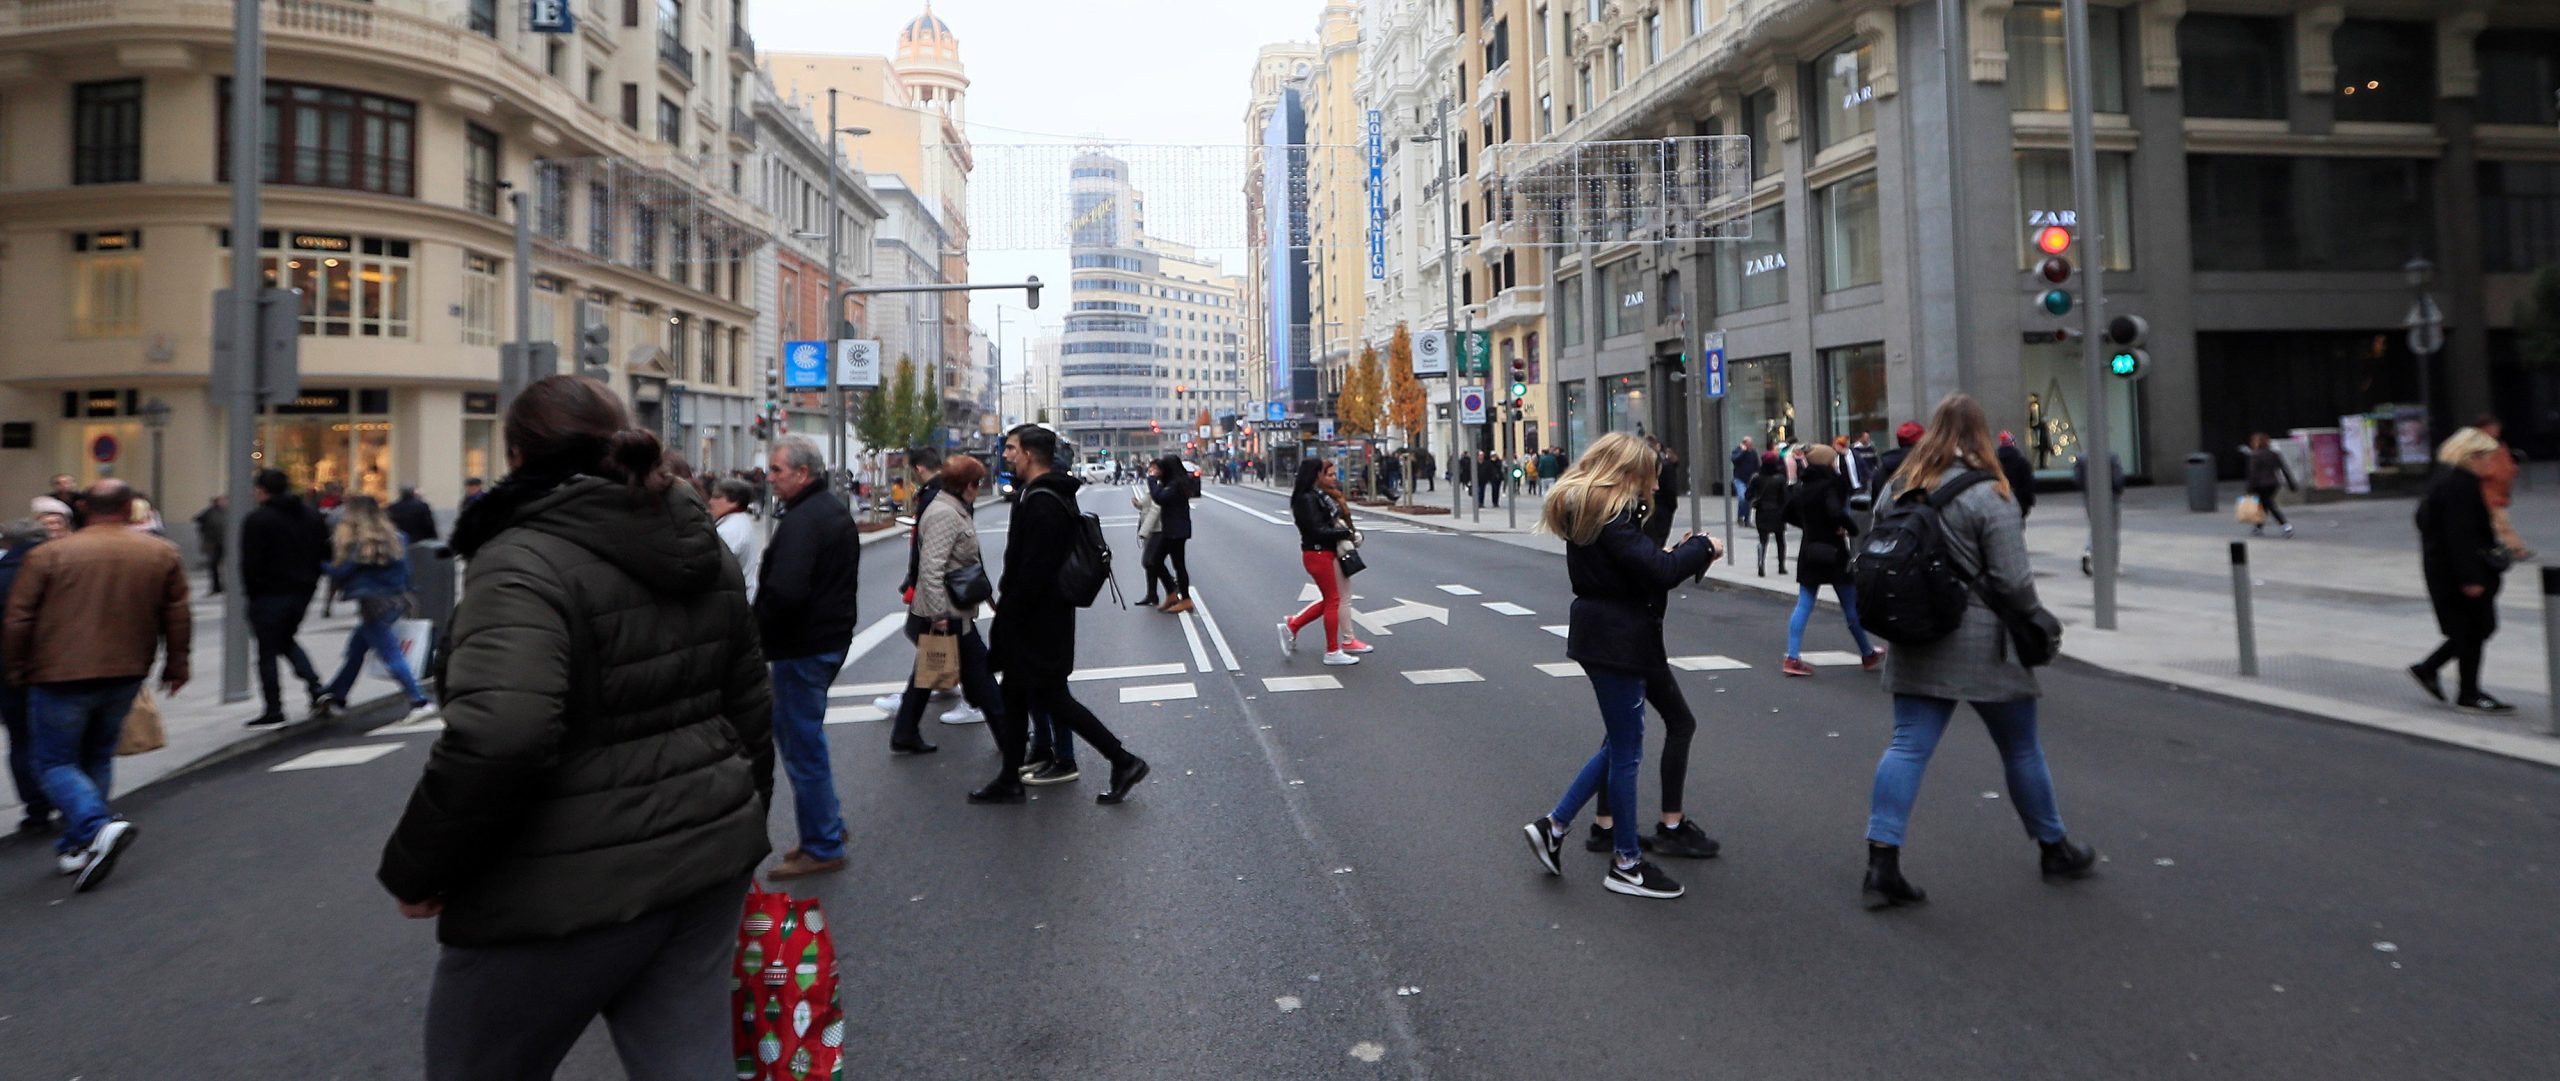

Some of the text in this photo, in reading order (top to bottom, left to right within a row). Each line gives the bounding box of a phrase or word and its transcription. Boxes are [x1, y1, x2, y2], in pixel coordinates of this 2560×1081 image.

[533, 0, 563, 27] E
[1843, 86, 1872, 109] ZAR
[1369, 111, 1384, 277] HOTEL ATLANTICO
[2028, 209, 2077, 225] ZAR
[1745, 252, 1786, 276] ZARA
[1624, 290, 1644, 307] ZAR
